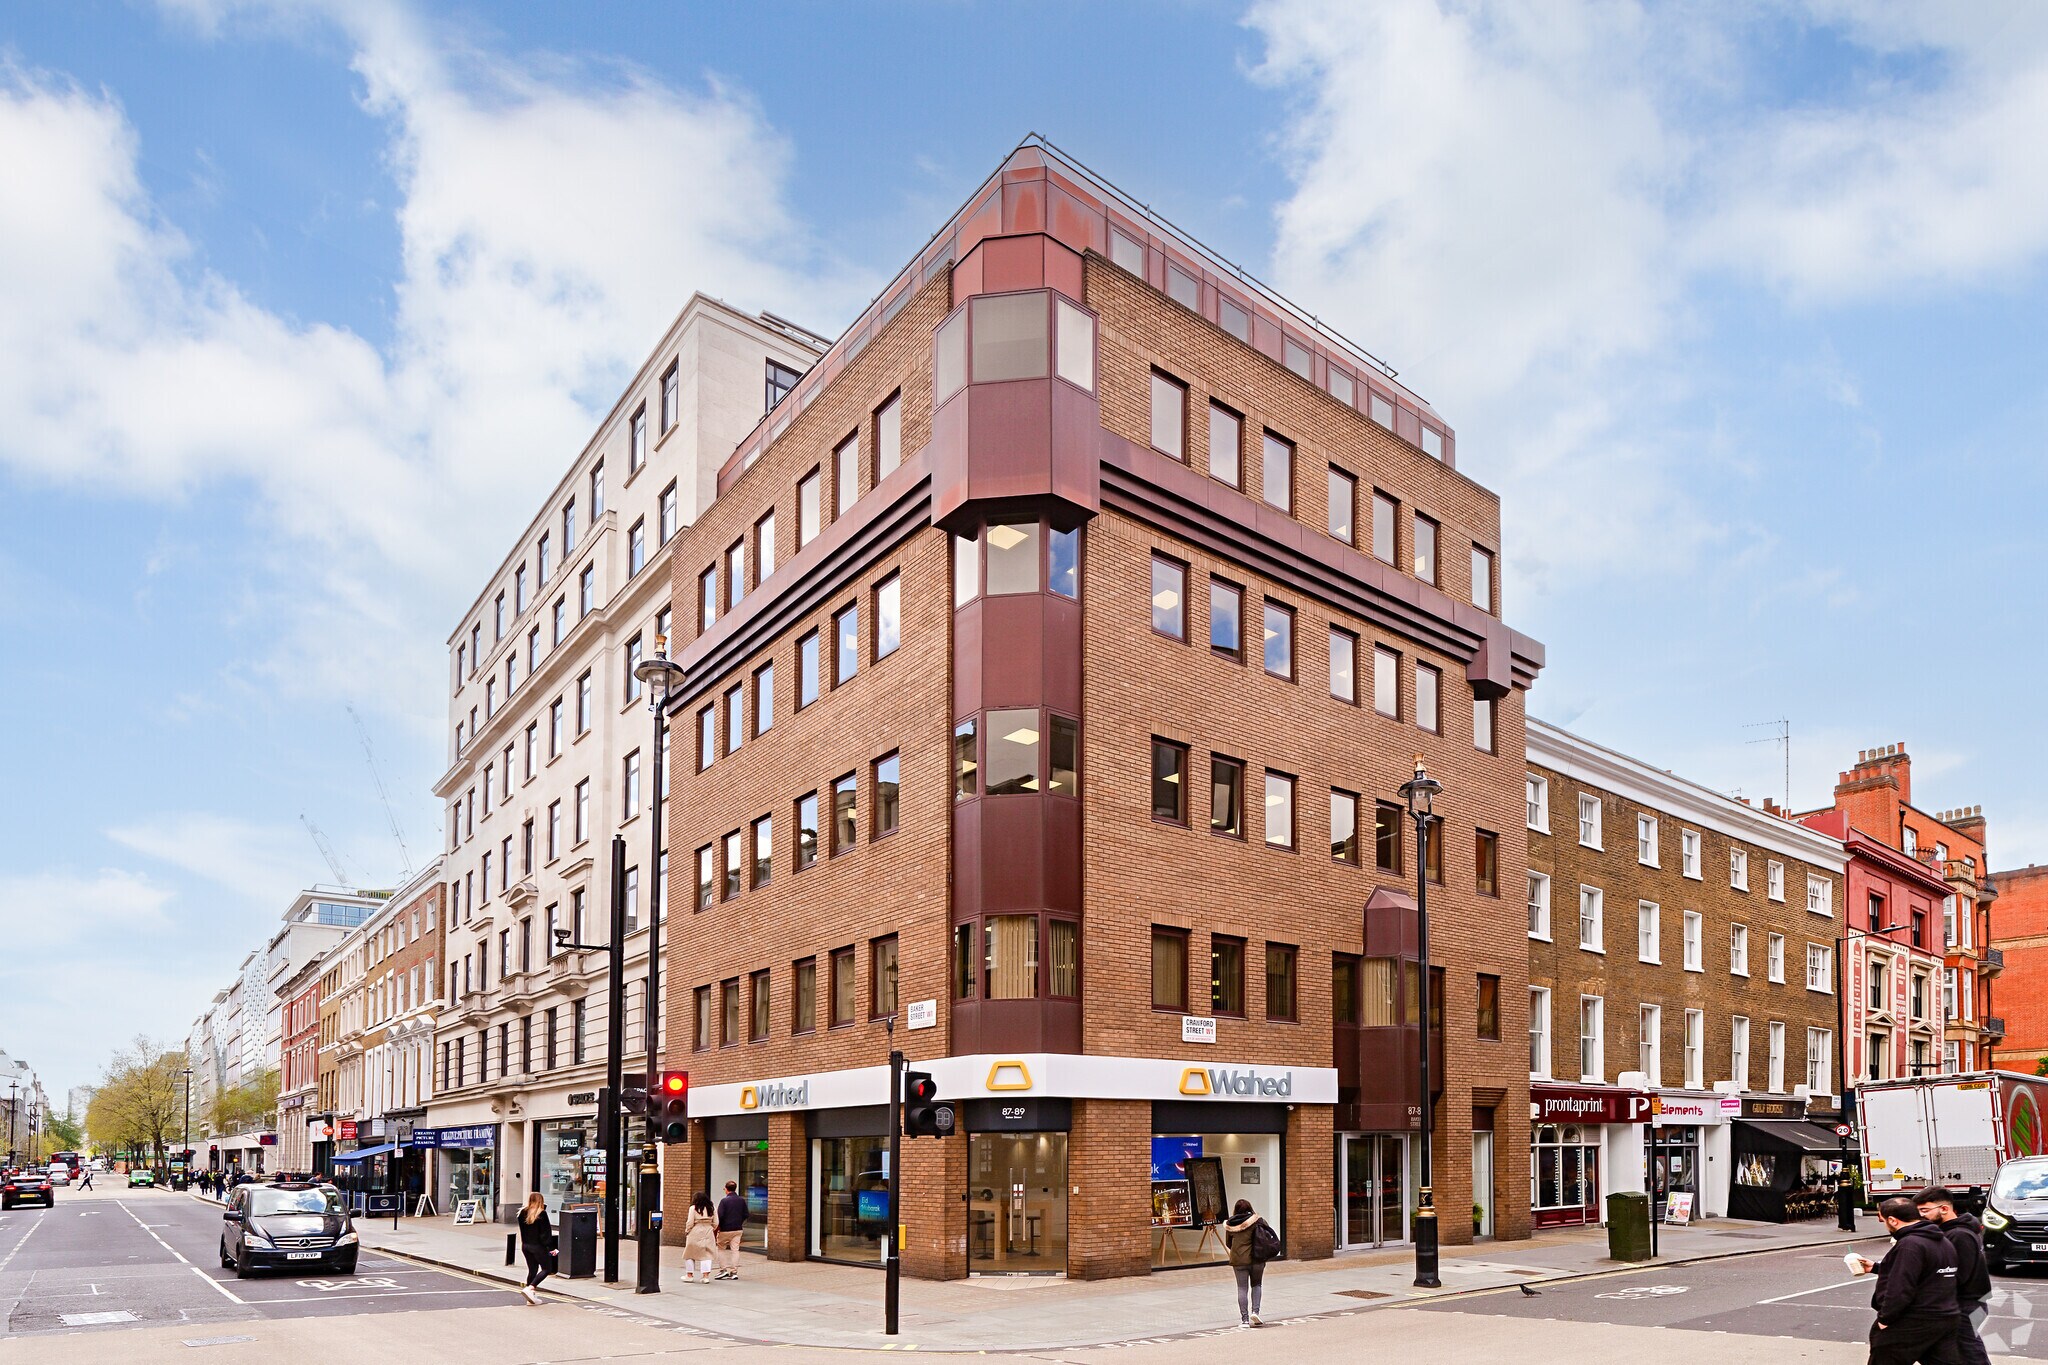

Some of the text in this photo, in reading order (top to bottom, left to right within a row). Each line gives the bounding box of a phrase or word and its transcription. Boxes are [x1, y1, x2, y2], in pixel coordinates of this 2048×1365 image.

[911, 1004, 924, 1012] BAKER
[910, 1011, 925, 1020] STREET
[1186, 1018, 1213, 1027] CRAWFORD
[1186, 1026, 1204, 1034] STREET
[1208, 1069, 1291, 1097] Wahed
[755, 1079, 808, 1107] Wahed
[1002, 1107, 1026, 1116] 87-89
[1408, 1106, 1421, 1115] 87-8
[1545, 1097, 1603, 1118] prontaprint
[1627, 1097, 1650, 1120] P
